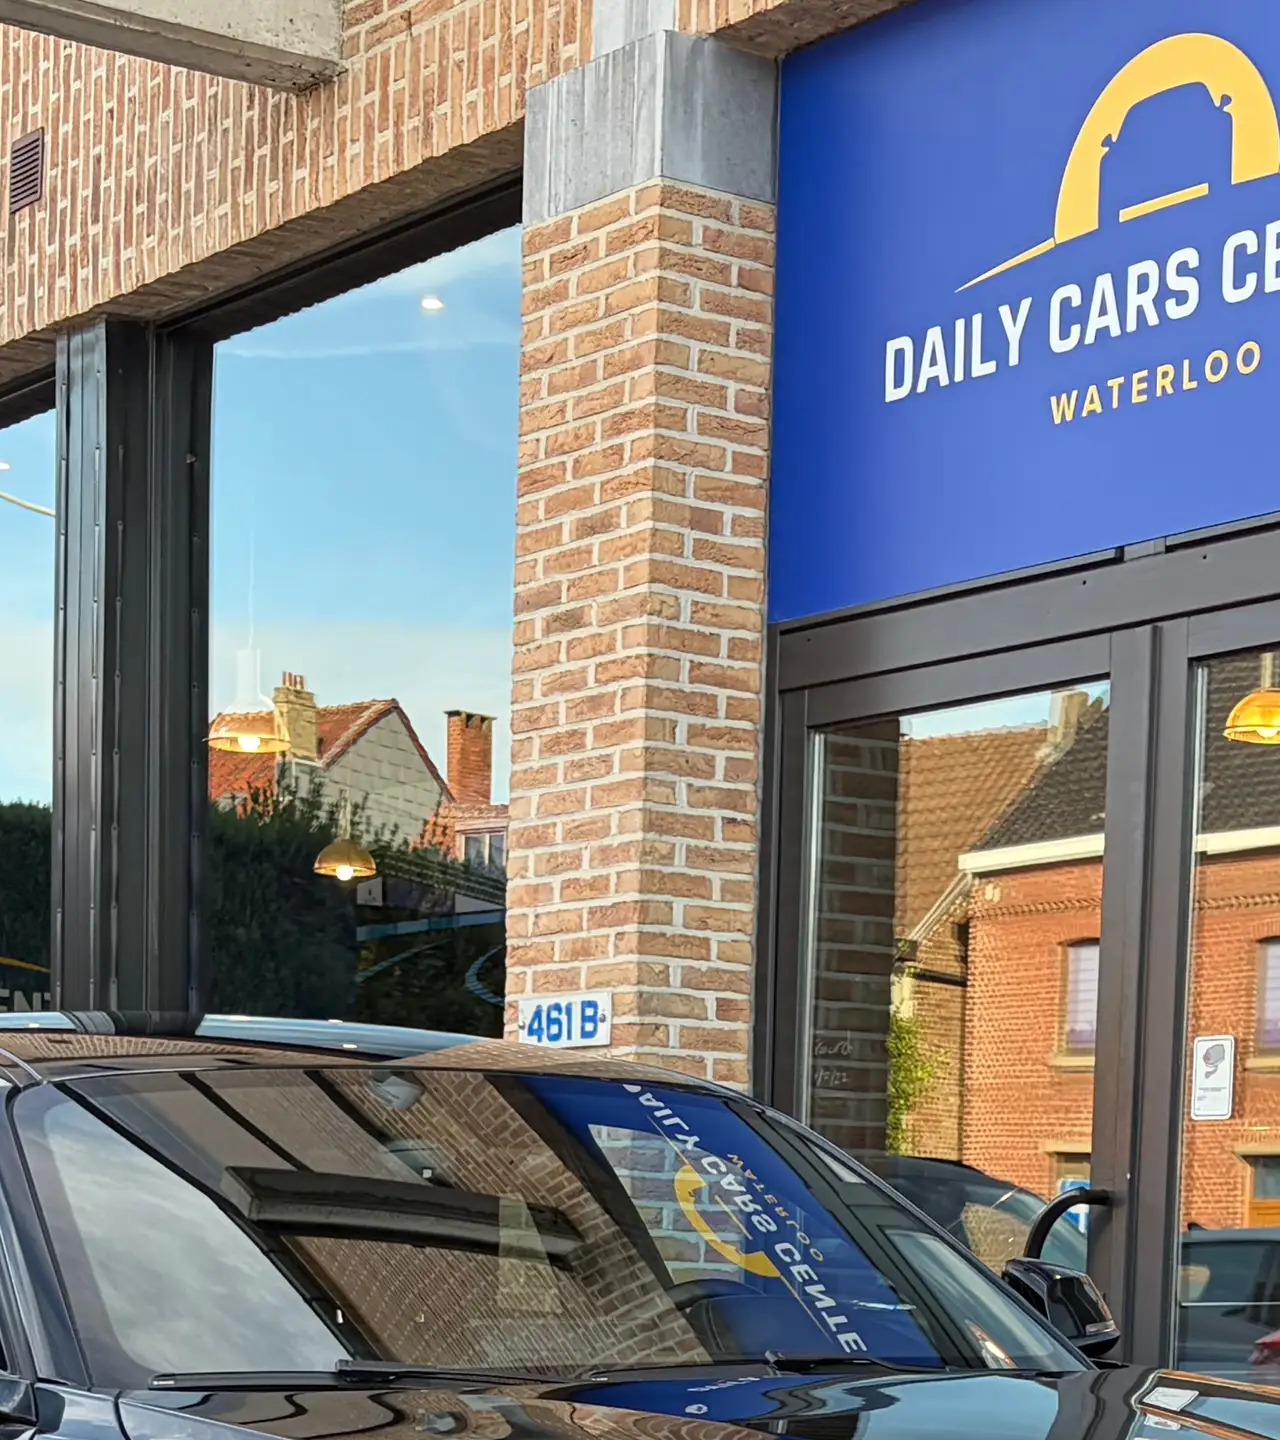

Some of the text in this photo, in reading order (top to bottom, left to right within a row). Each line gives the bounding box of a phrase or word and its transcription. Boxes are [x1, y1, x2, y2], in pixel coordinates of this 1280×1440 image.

[884, 295, 1032, 403] DAILY
[1049, 246, 1201, 354] CARS
[1050, 340, 1263, 426] WATERLOO
